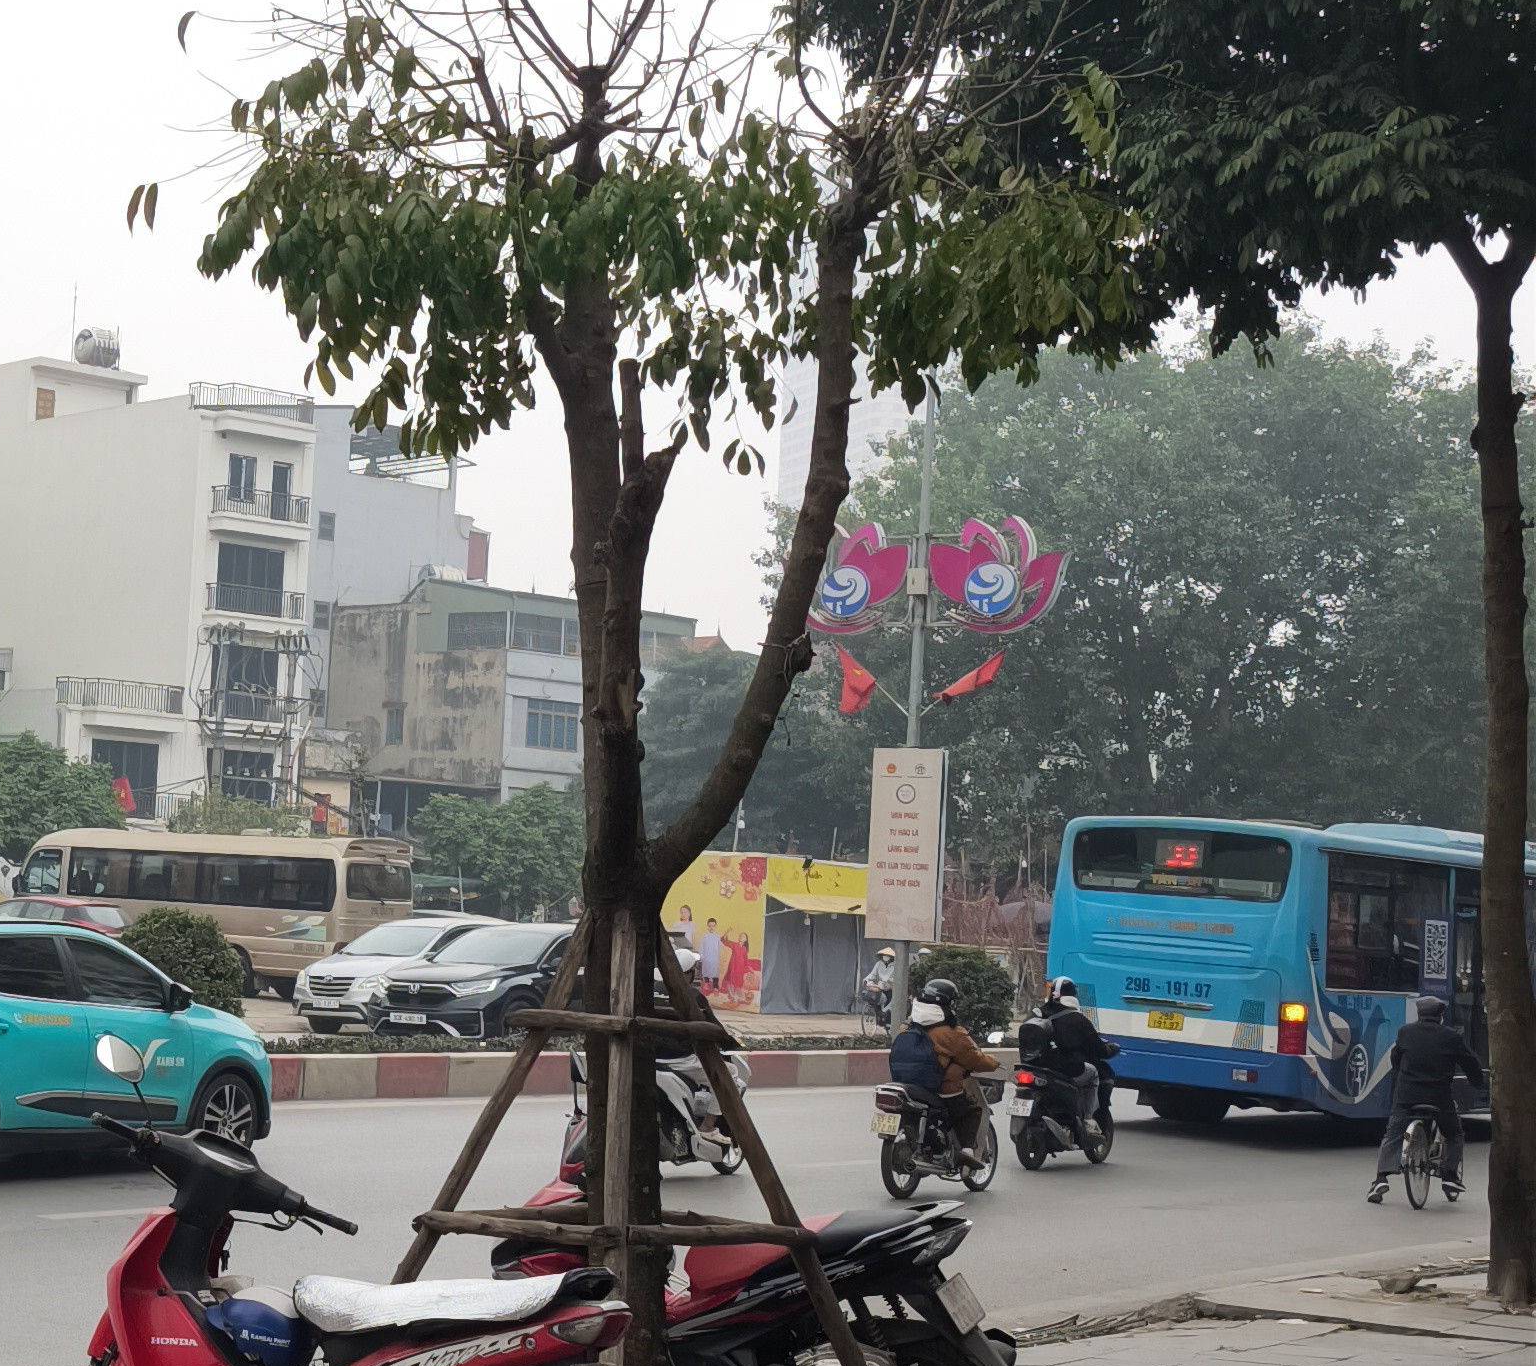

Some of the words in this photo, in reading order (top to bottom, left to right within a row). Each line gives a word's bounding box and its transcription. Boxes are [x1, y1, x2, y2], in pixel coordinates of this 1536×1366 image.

[1125, 977, 1150, 992] 29B
[1165, 981, 1212, 998] 191.97
[151, 1337, 198, 1346] HONDA
